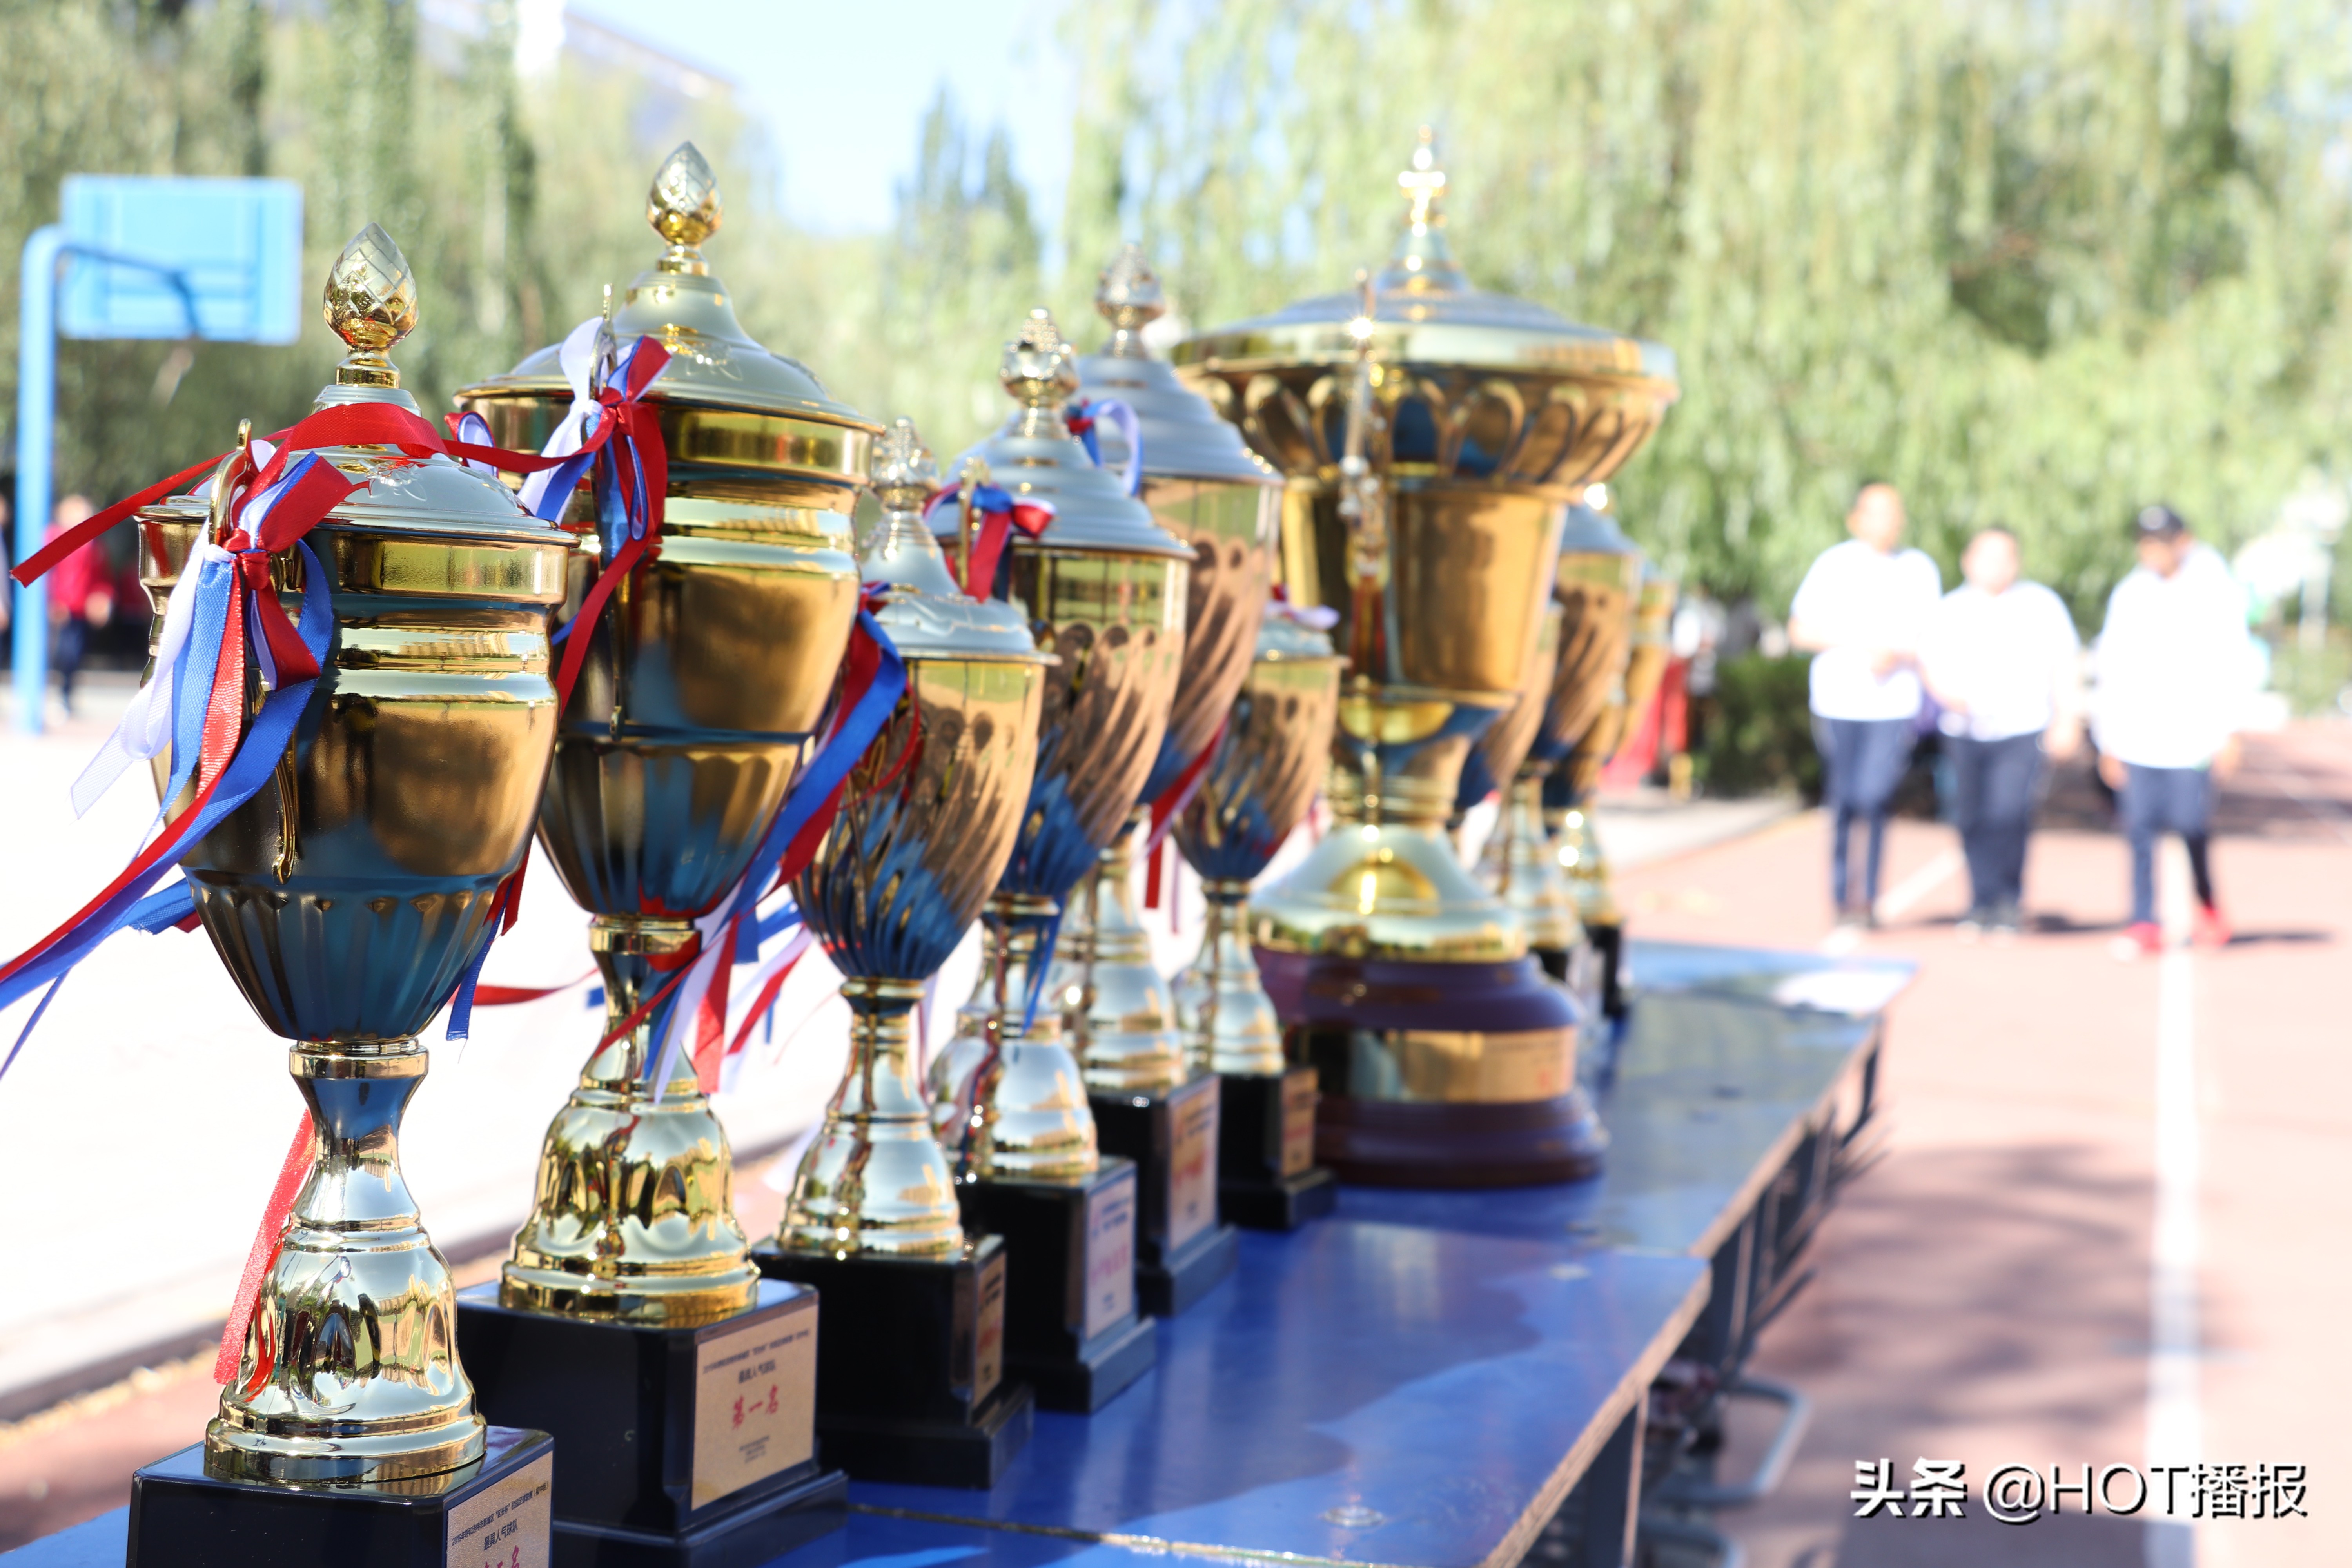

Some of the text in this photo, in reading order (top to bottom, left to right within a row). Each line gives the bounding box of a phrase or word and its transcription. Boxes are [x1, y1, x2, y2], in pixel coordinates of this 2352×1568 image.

[732, 1385, 779, 1430] 第一名
[483, 1518, 518, 1550] 最具人气球队
